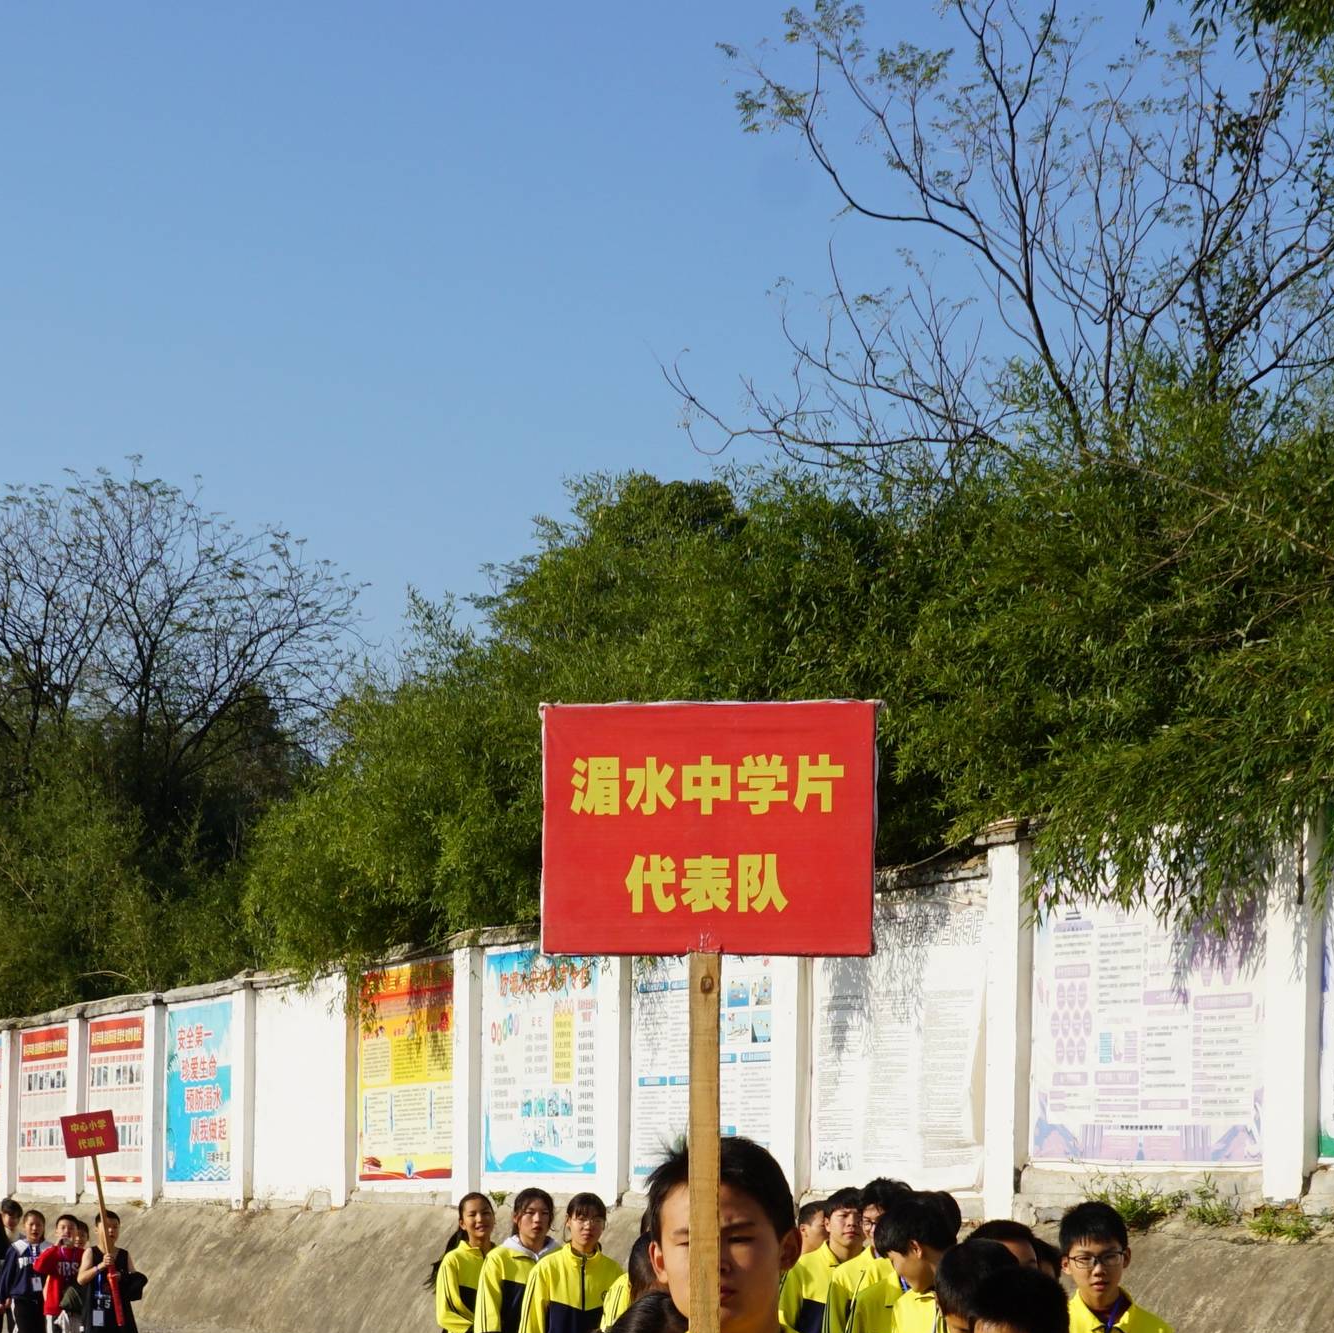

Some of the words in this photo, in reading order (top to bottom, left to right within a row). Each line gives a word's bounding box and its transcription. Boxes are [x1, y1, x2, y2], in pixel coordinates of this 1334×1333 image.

[570, 754, 845, 816] 湄水中学片
[625, 853, 788, 913] 代表队
[177, 1024, 213, 1051] 安全第一
[181, 1055, 217, 1081] 珍爱生命
[186, 1085, 222, 1112] 预防溺水
[70, 1119, 107, 1133] 中心小学
[191, 1117, 227, 1143] 从我做起
[78, 1136, 105, 1150] 代表队
